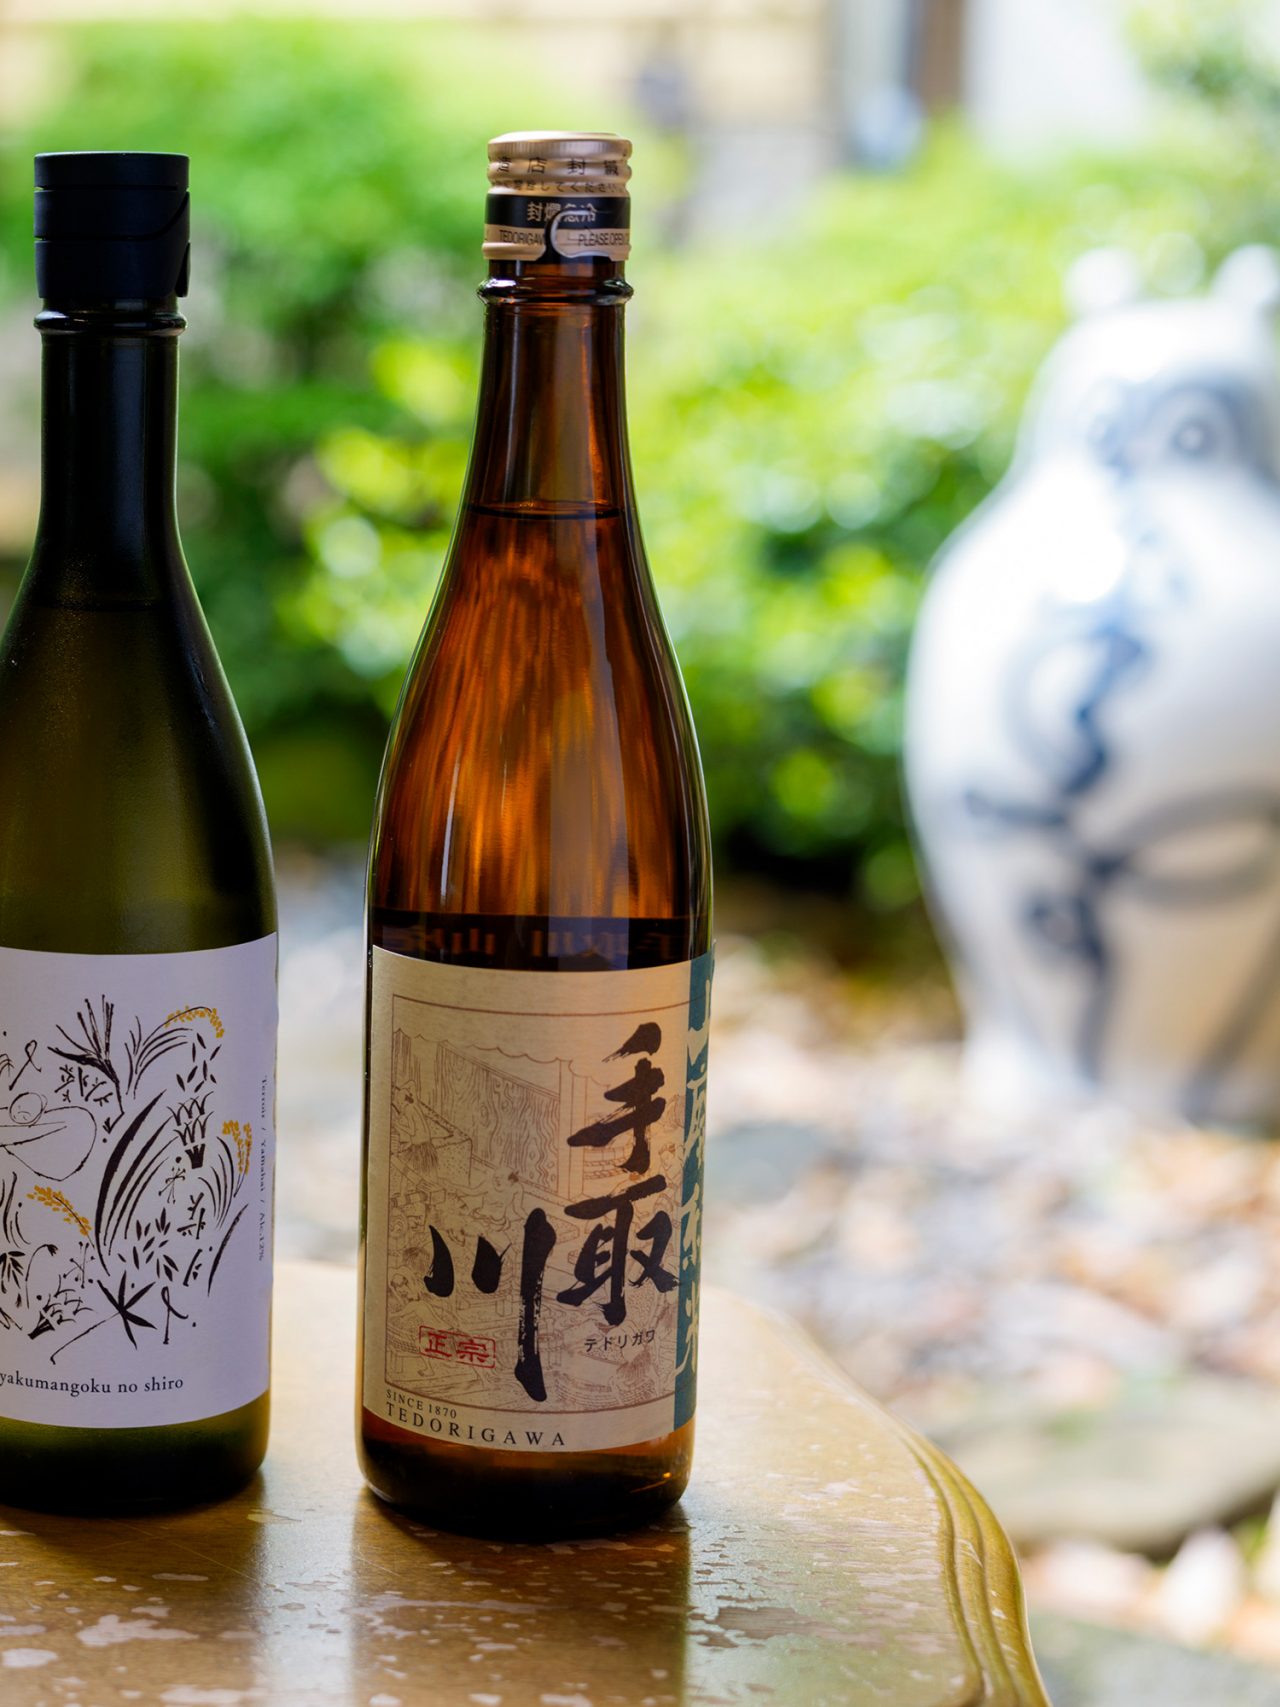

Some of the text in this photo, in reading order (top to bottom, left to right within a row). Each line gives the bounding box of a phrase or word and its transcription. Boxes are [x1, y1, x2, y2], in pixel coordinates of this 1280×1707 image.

[578, 232, 609, 247] PLEASE
[424, 1331, 489, 1363] 正宗
[584, 1329, 656, 1353] テドリガワ
[117, 1382, 138, 1393] no
[144, 1376, 184, 1393] shiro
[386, 1388, 457, 1419] SINCE 1870
[386, 1401, 566, 1447] TEDORIGAWA
